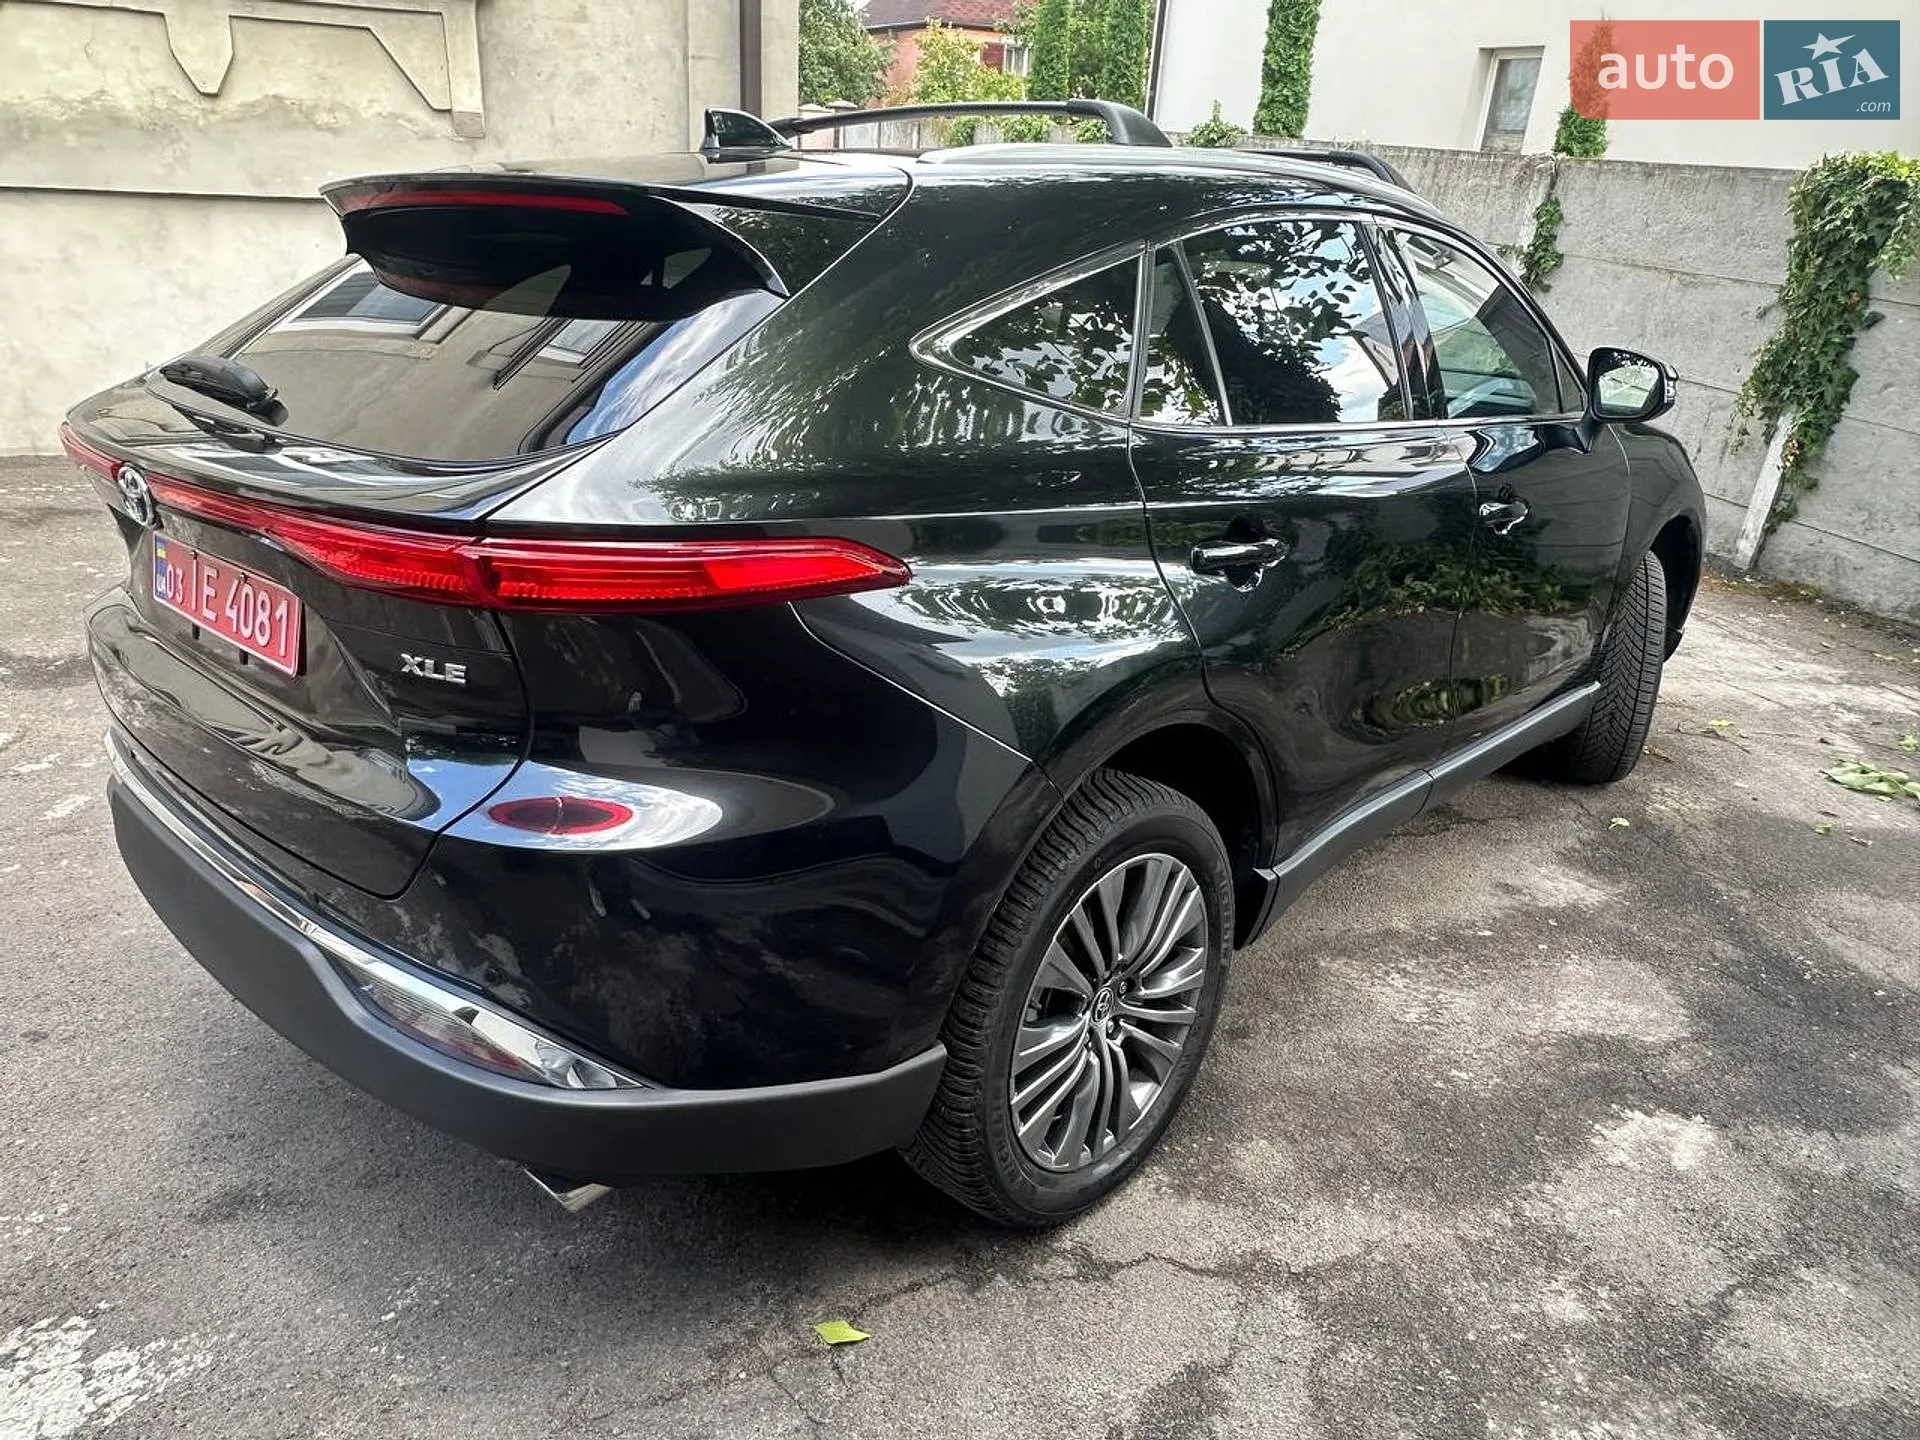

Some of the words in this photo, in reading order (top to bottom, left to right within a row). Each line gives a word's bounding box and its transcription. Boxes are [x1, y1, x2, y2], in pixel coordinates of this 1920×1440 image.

[166, 563, 183, 604] 03
[191, 552, 218, 622] IE
[225, 573, 288, 657] 4081
[401, 653, 467, 684] XLE
